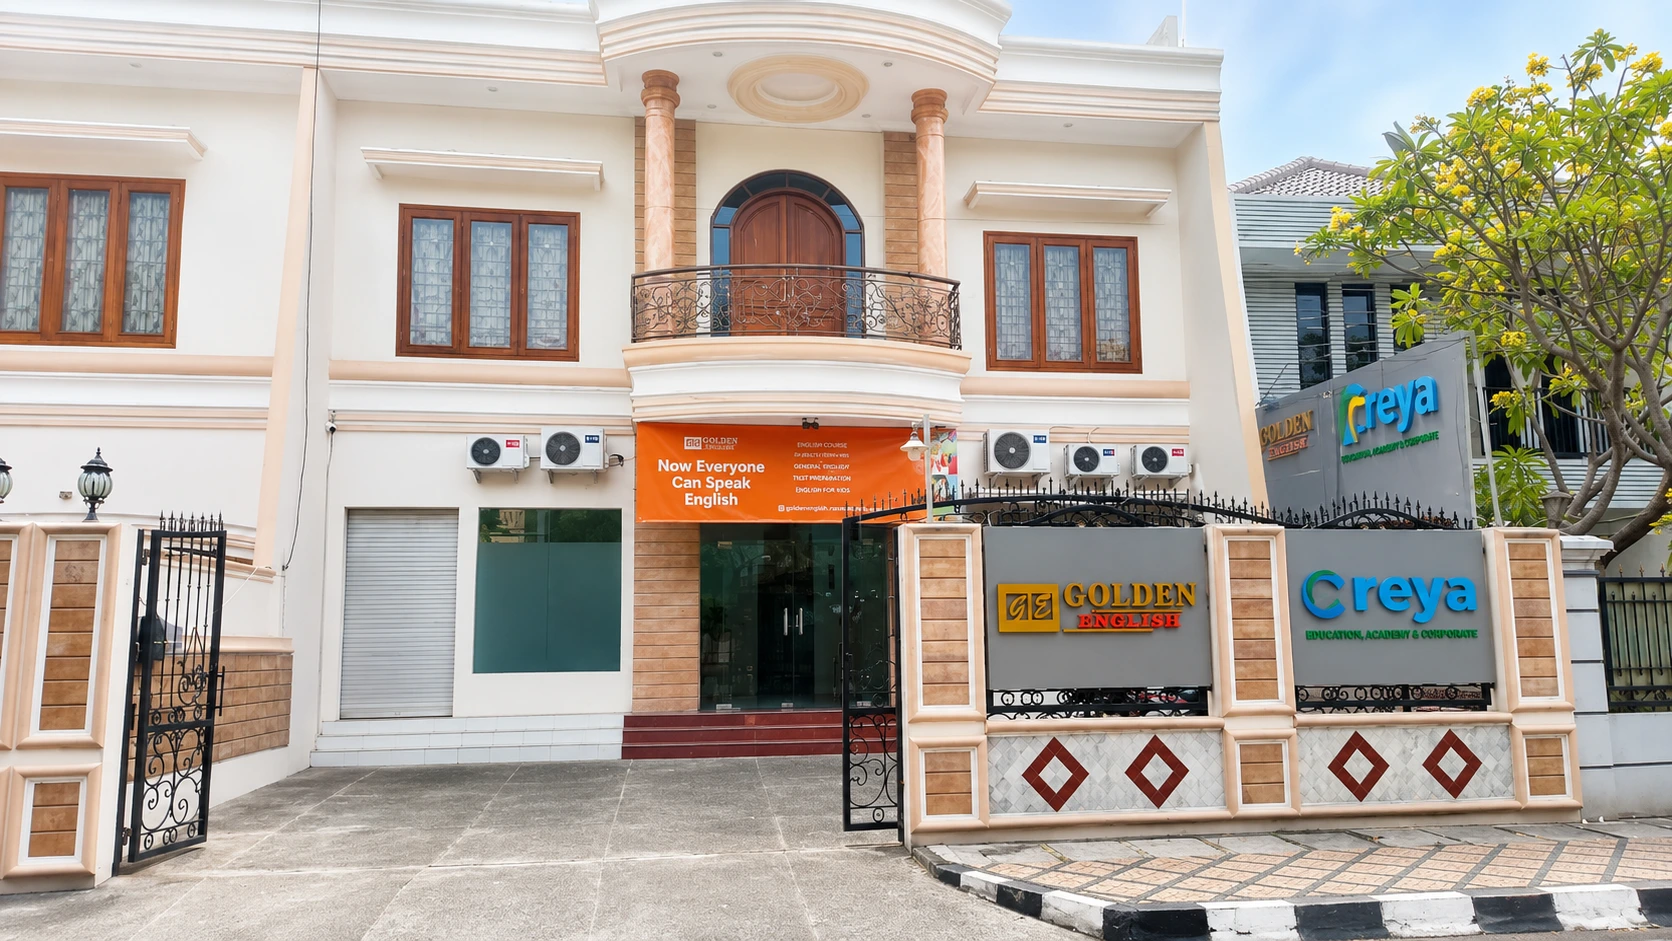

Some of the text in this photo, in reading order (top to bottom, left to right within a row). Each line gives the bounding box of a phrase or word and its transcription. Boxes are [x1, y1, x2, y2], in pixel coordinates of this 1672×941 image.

[657, 459, 765, 476] Now Everyone
[672, 476, 751, 492] Can Speak
[684, 492, 738, 508] English
[1063, 583, 1196, 607] GOLDEN
[1302, 569, 1478, 624] Creya
[1078, 613, 1181, 629] ENGLISH
[1305, 630, 1364, 641] EDUCATION,
[1420, 629, 1478, 640] CORPORATE
